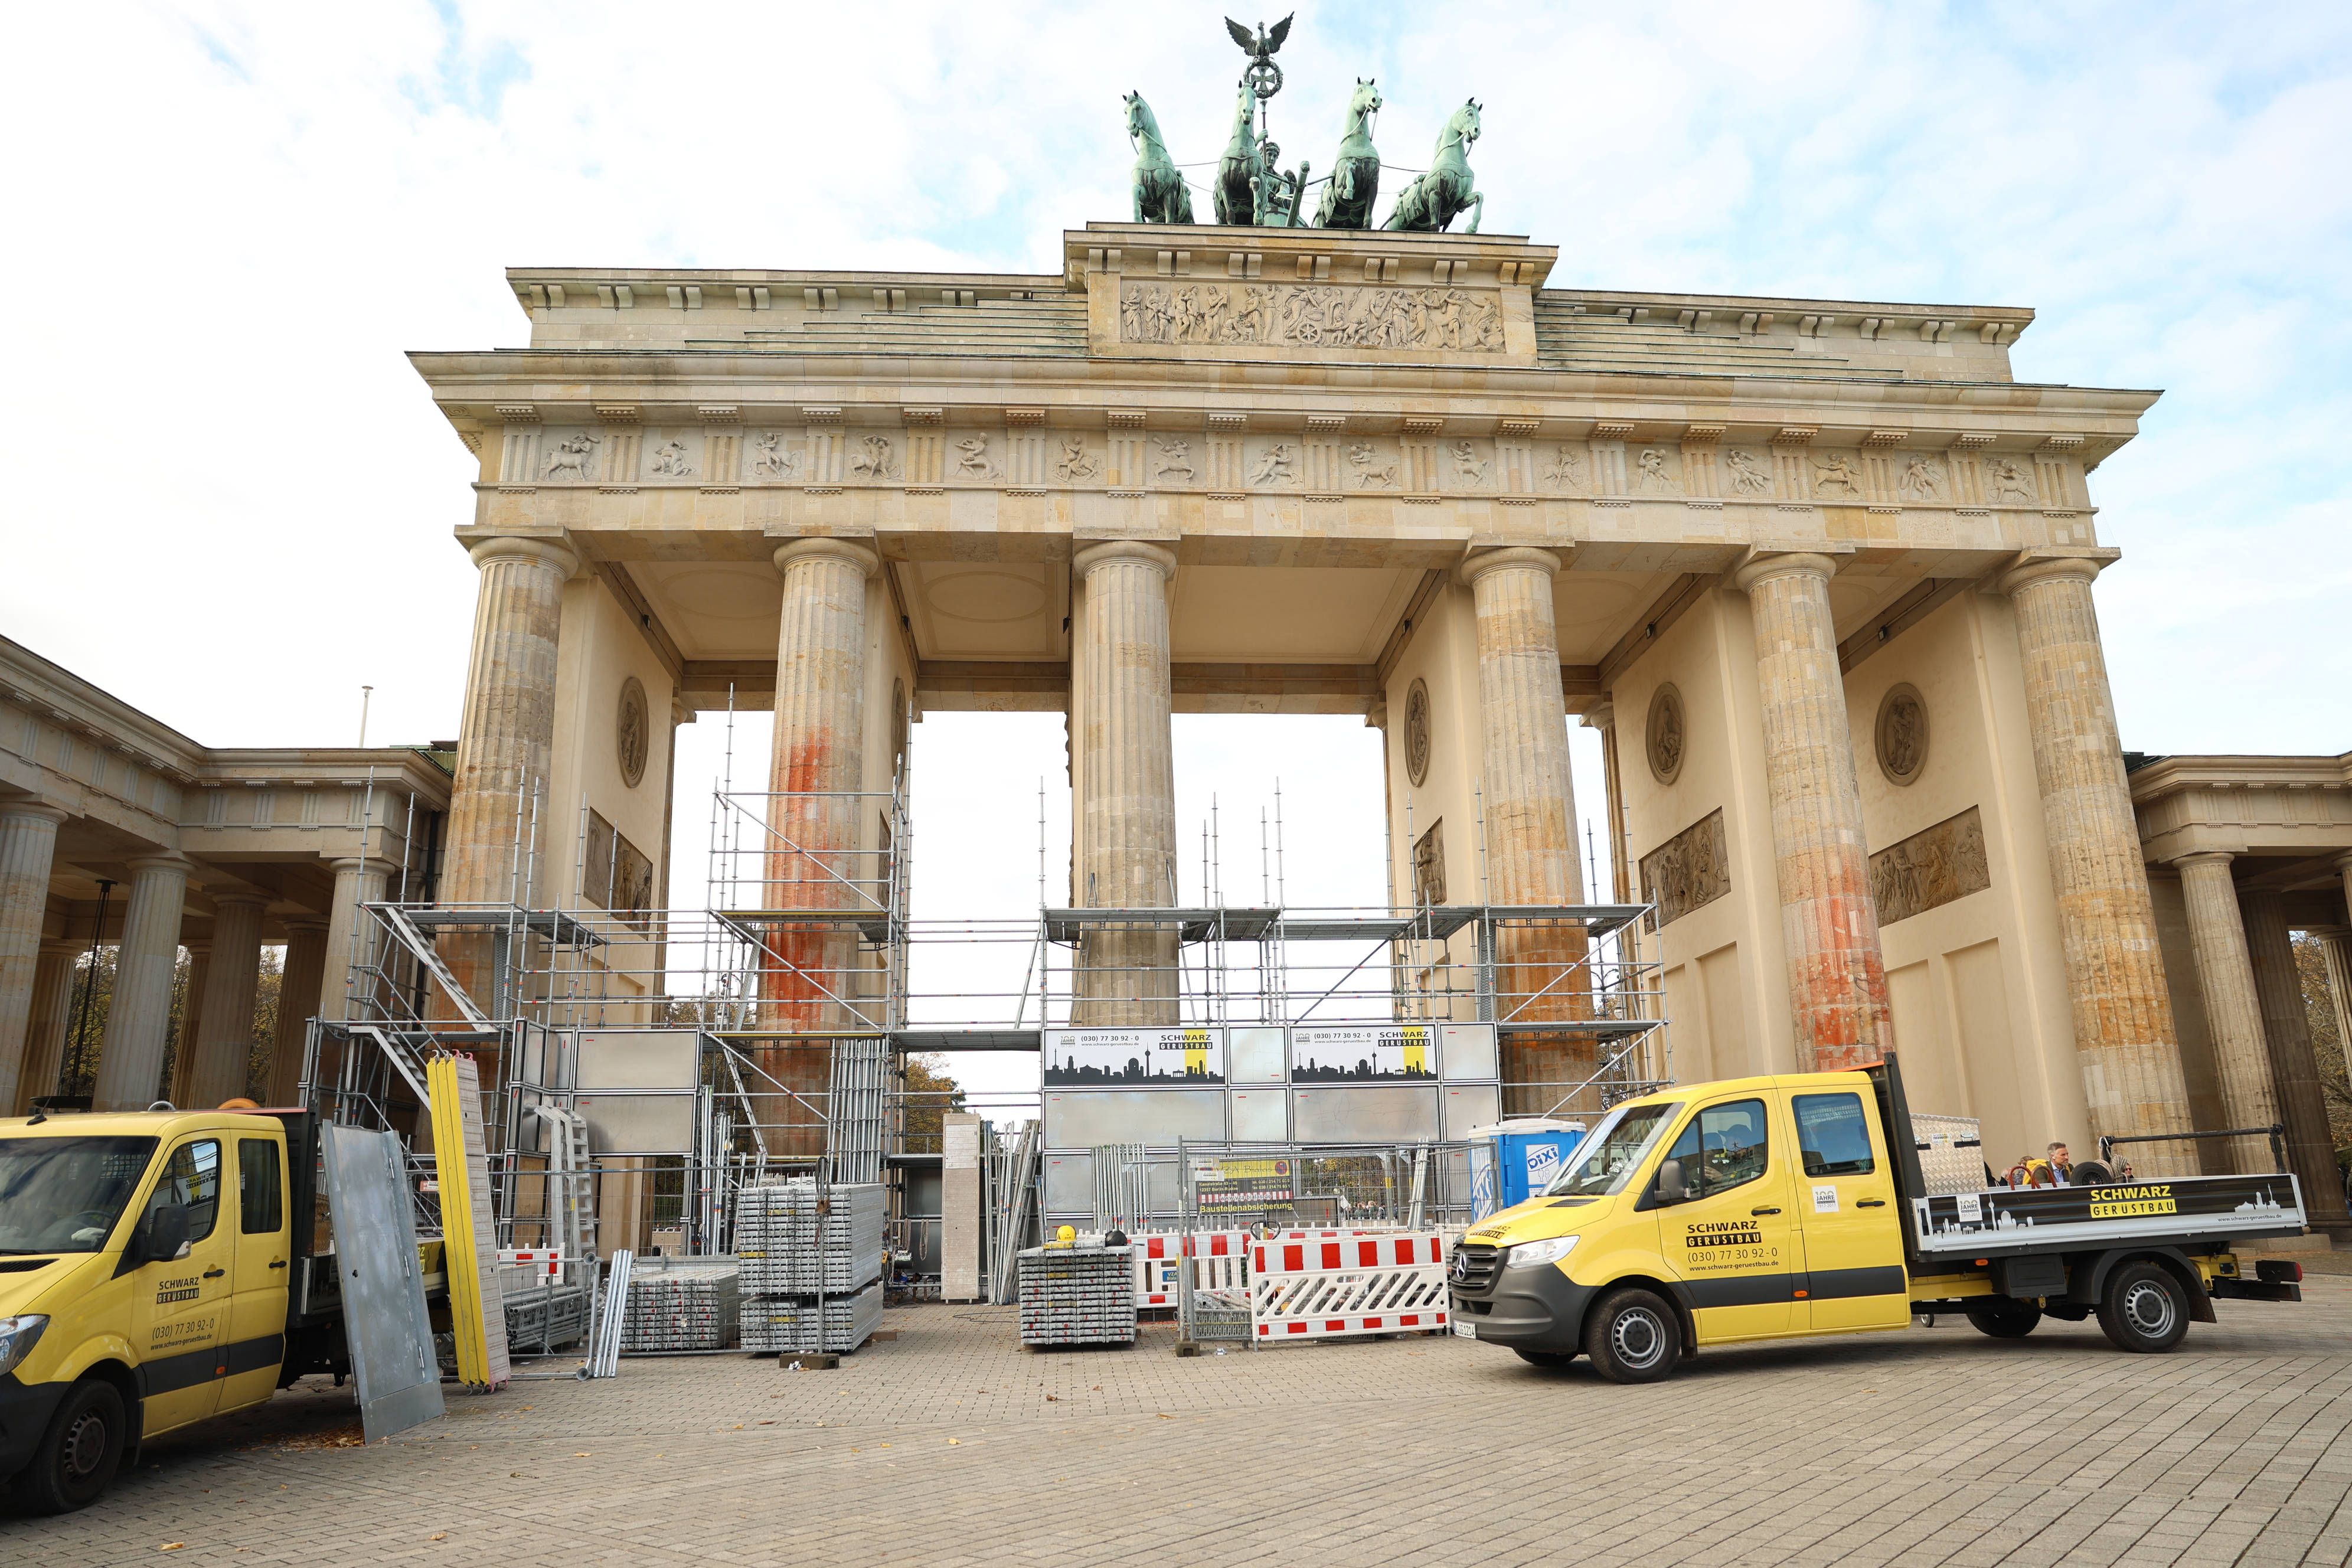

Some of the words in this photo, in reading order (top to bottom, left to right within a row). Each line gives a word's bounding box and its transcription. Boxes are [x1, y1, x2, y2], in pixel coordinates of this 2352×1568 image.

[2090, 1185, 2171, 1201] SCHWARZ
[1200, 1203, 1293, 1213] Baustellenabsicherung
[2093, 1202, 2174, 1216] GERÜSTBAU
[2217, 1214, 2282, 1223] www.schwarz-geruestbau.de
[1687, 1221, 1758, 1233] SCHWARZ
[1688, 1234, 1759, 1246] GERÜSTBAU
[1688, 1251, 1716, 1263] (030)
[1720, 1250, 1731, 1260] 77
[1736, 1249, 1748, 1259] 30
[1689, 1260, 1779, 1271] www.schwarz-geruestbau.de
[159, 1277, 199, 1290] SCHWARZ
[158, 1289, 198, 1303] GERÜSTBAU
[152, 1325, 172, 1340] (030)
[176, 1324, 184, 1335] 77
[186, 1321, 195, 1333] 30
[151, 1334, 212, 1350] www.schwarz-geruestbau.de
